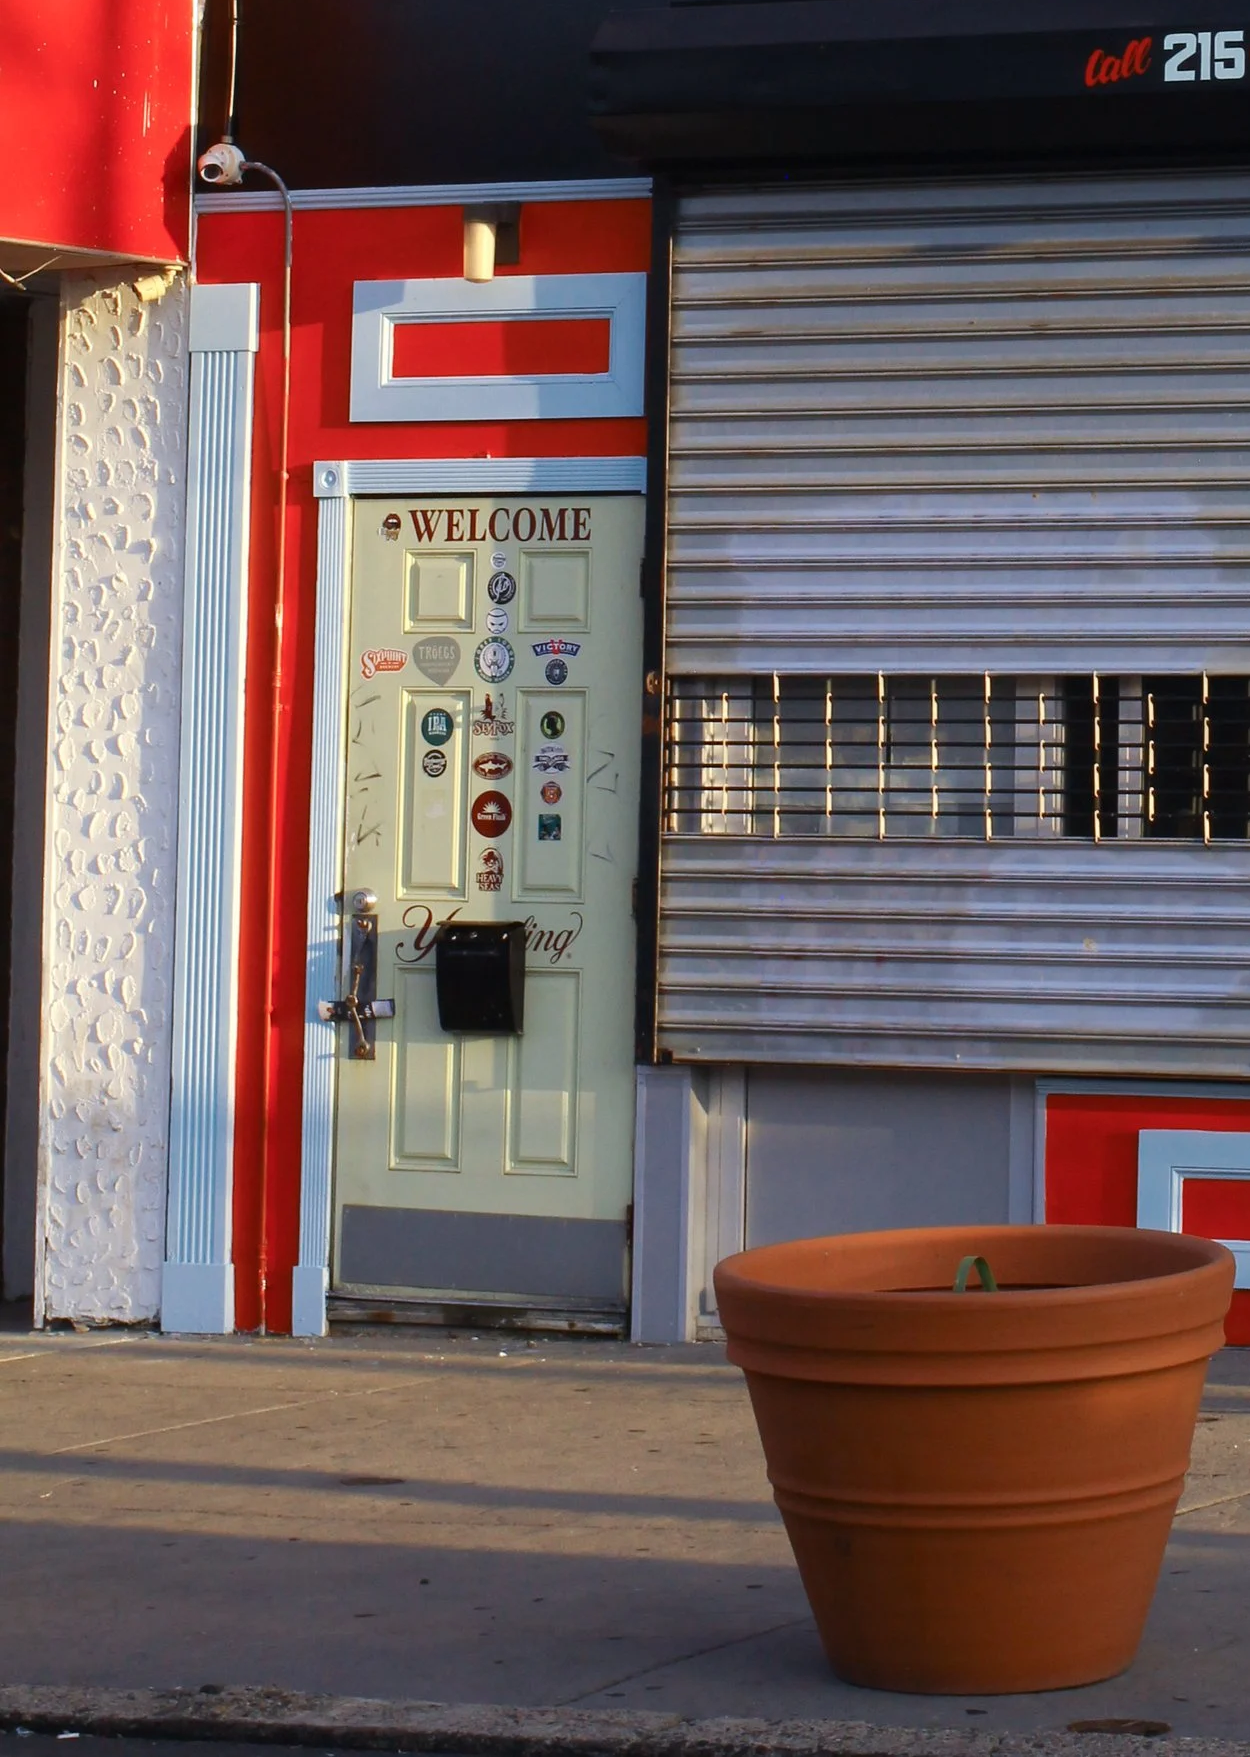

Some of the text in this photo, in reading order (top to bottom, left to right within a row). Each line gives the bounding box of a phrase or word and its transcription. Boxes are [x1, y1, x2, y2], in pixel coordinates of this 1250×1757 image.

[1084, 37, 1153, 87] Call
[408, 507, 592, 543] WELCOME
[535, 643, 578, 652] VICTORY
[427, 716, 447, 731] IPA
[476, 873, 504, 883] HEAVY
[479, 882, 501, 891] SEAS
